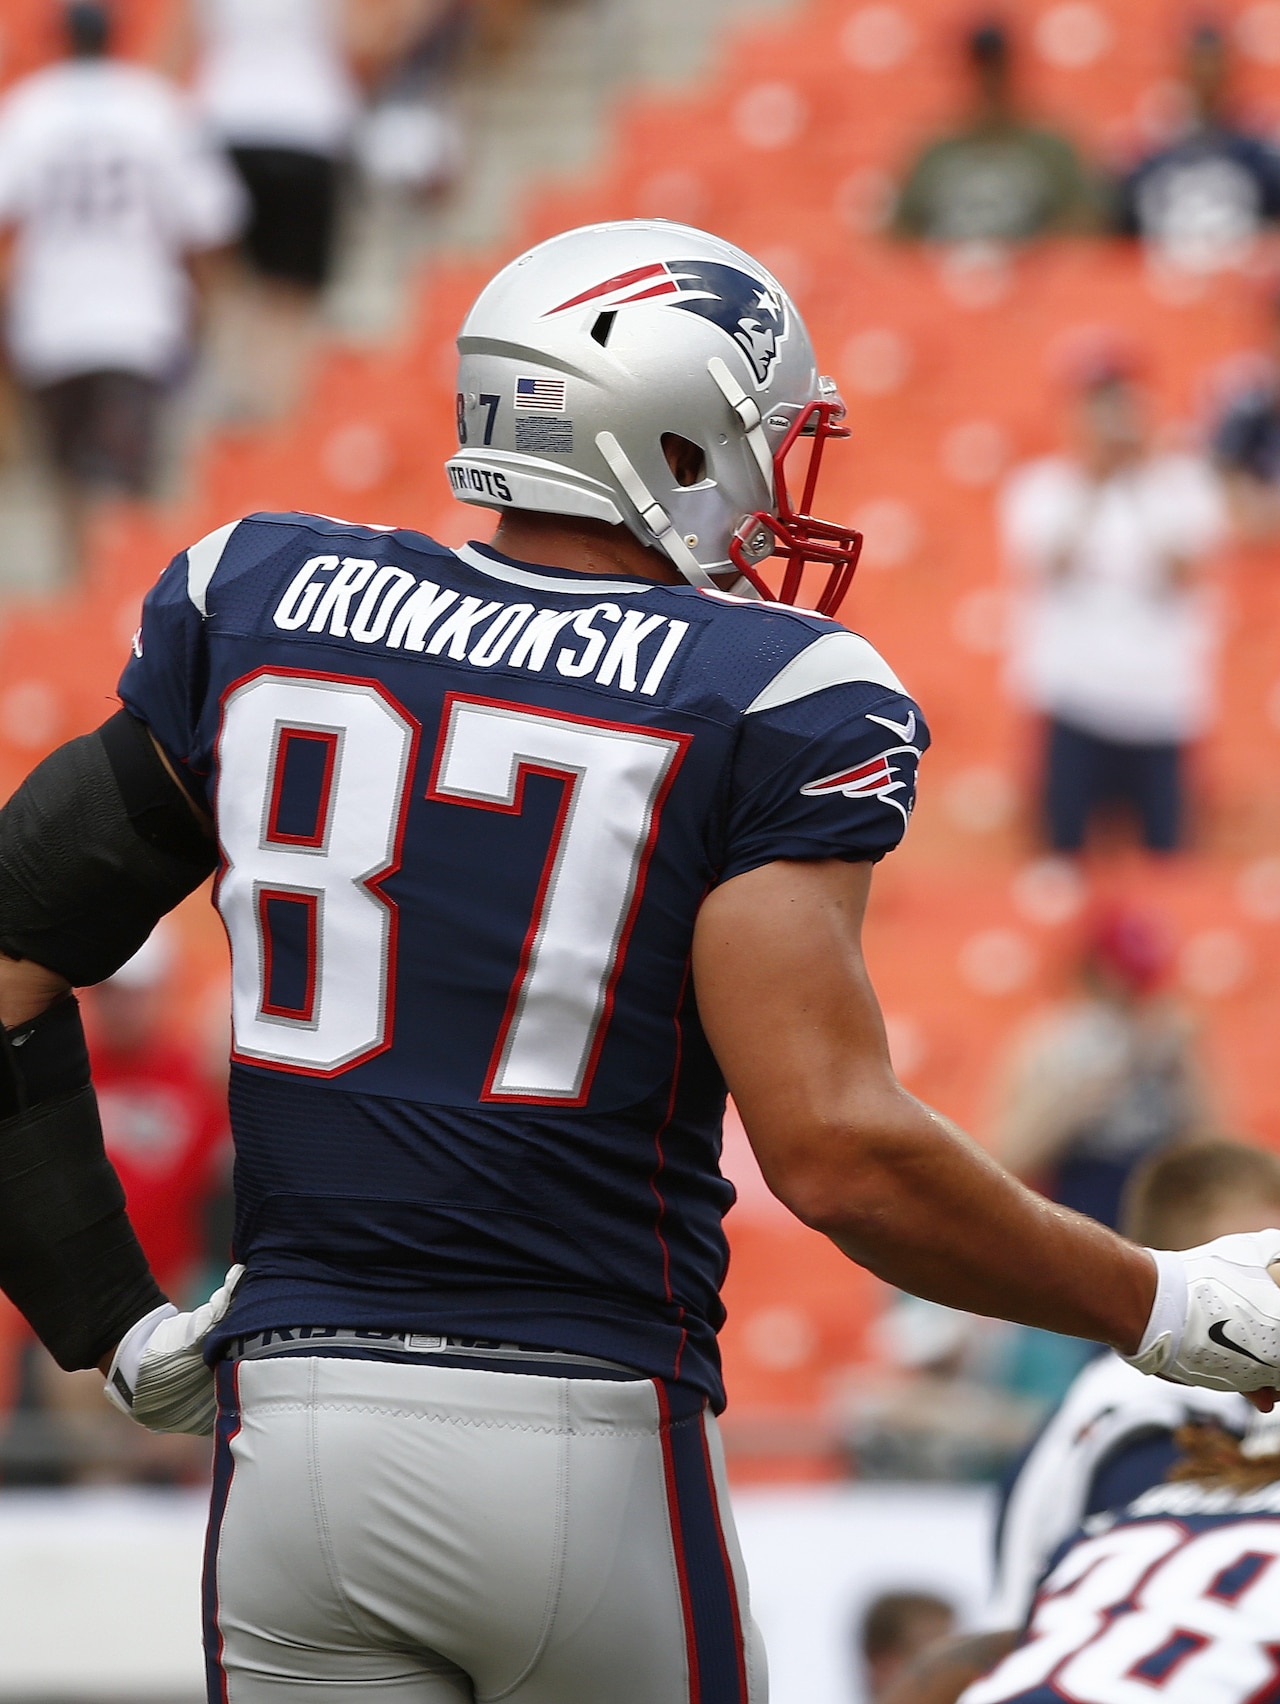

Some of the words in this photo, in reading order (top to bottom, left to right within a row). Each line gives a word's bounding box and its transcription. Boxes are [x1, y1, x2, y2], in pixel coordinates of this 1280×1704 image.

[449, 466, 513, 502] TRIOTS
[272, 555, 690, 697] GRONKOWSKI
[211, 664, 695, 1108] 87
